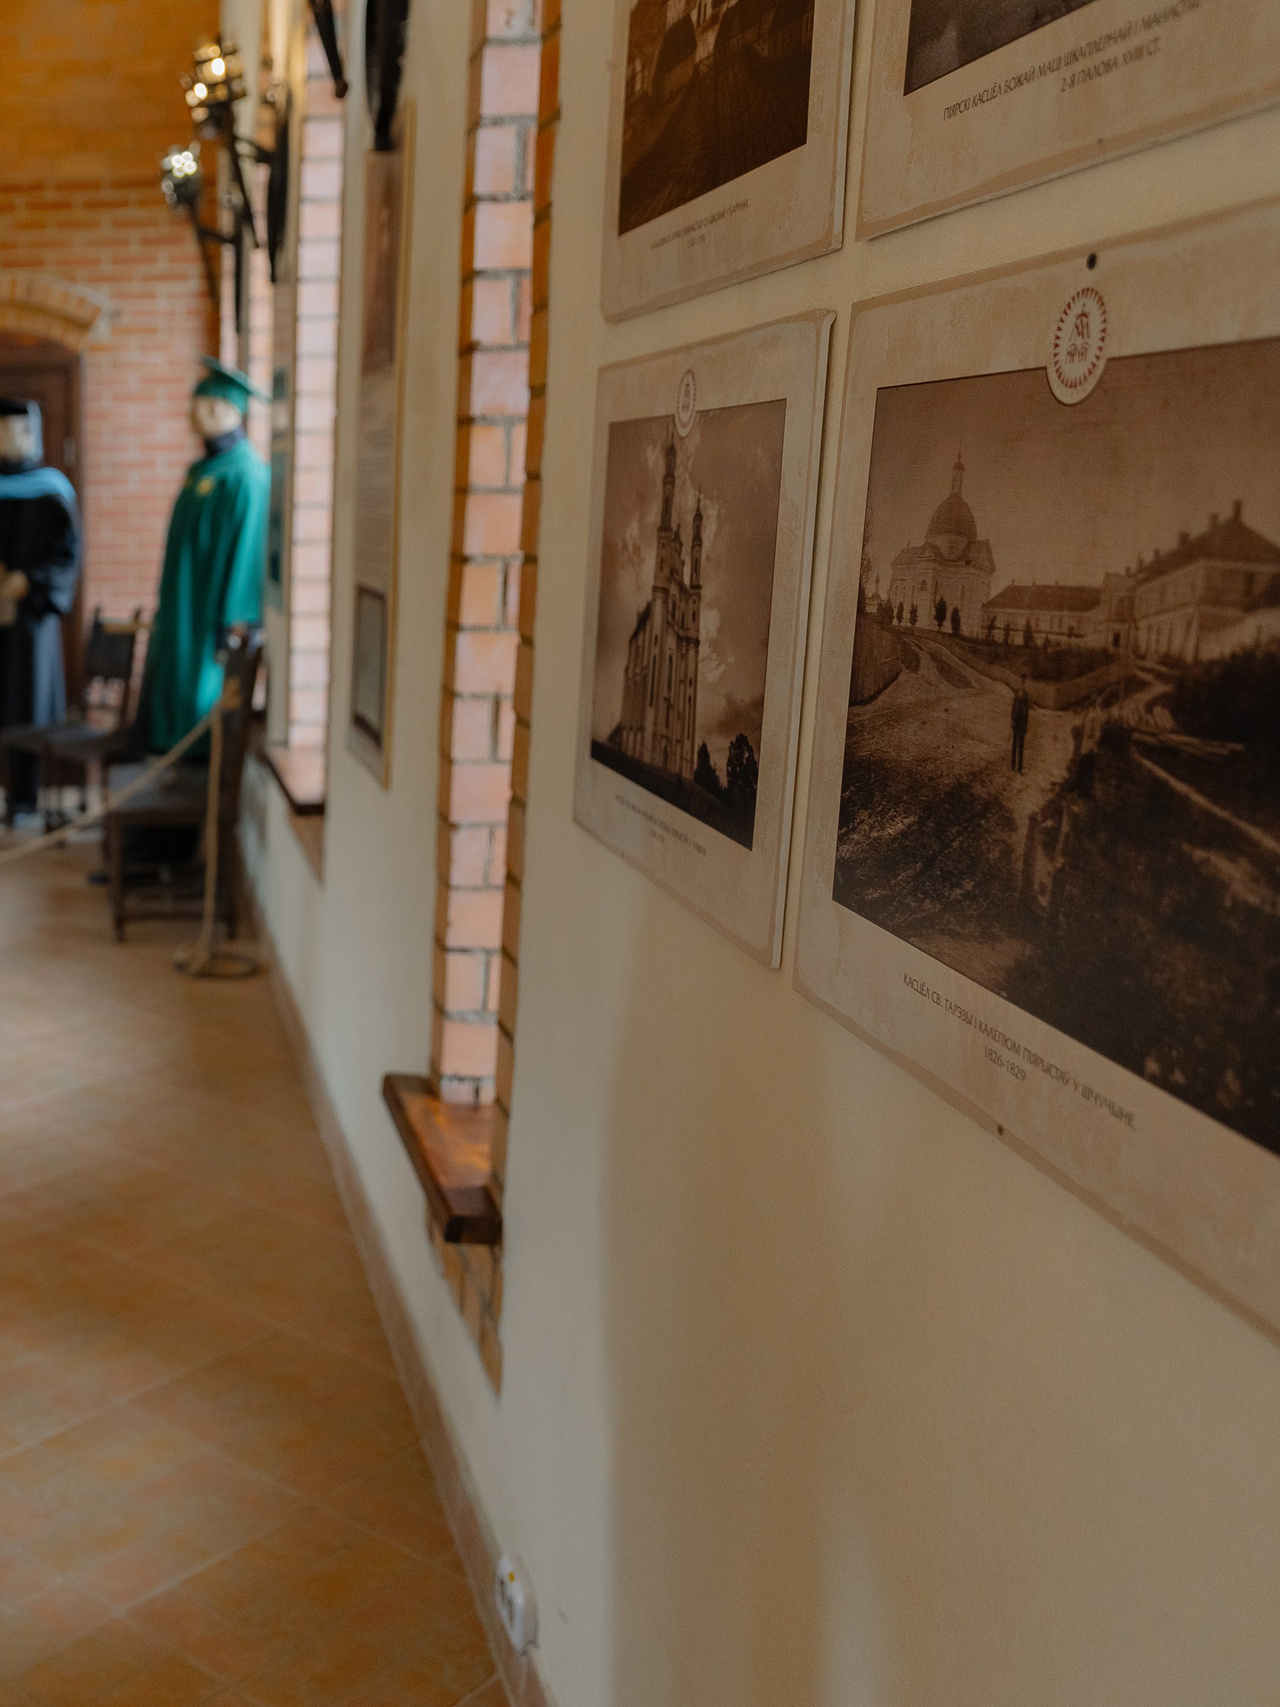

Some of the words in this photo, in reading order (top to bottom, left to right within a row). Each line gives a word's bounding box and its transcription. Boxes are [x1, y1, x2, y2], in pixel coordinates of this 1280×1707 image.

[972, 82, 1002, 108] КАСЦЁЛ
[1003, 64, 1036, 94] БОЖАЙ
[903, 973, 930, 999] КАСЦЁЛ
[931, 991, 942, 1007] СВ.
[944, 997, 973, 1026] ТАРЭЗЫ
[984, 1046, 1026, 1082] 1826-1829
